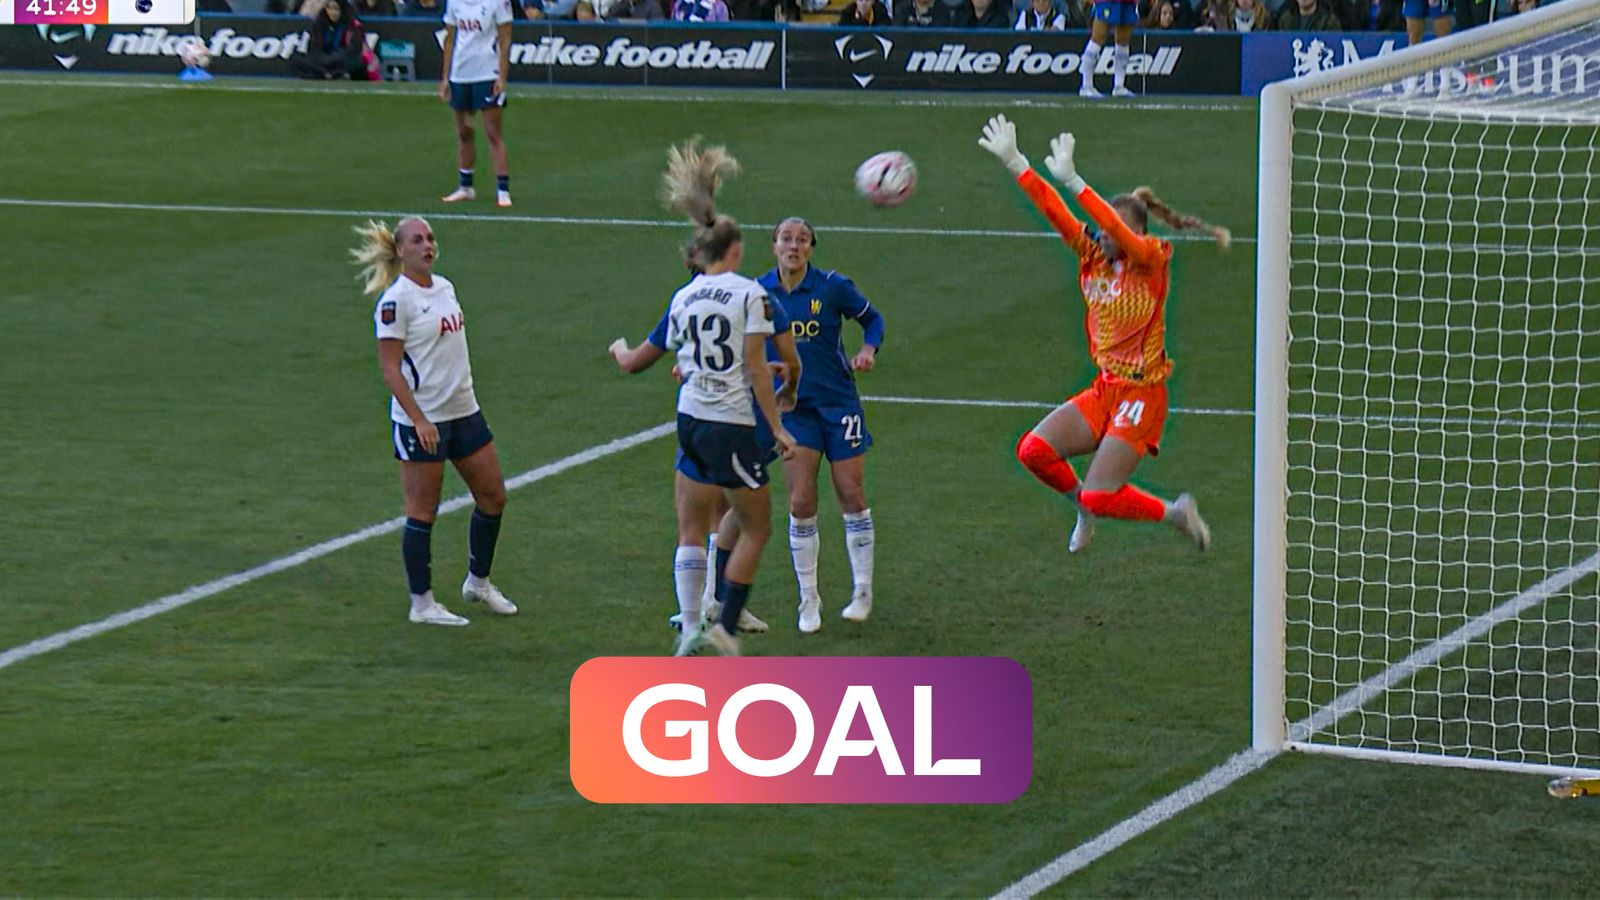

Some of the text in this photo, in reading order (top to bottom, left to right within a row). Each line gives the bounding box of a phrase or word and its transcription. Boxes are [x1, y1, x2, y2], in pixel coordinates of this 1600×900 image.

[509, 37, 775, 70] nike football
[906, 45, 1182, 76] nike fooball
[687, 314, 735, 371] 13
[1113, 400, 1145, 427] 24
